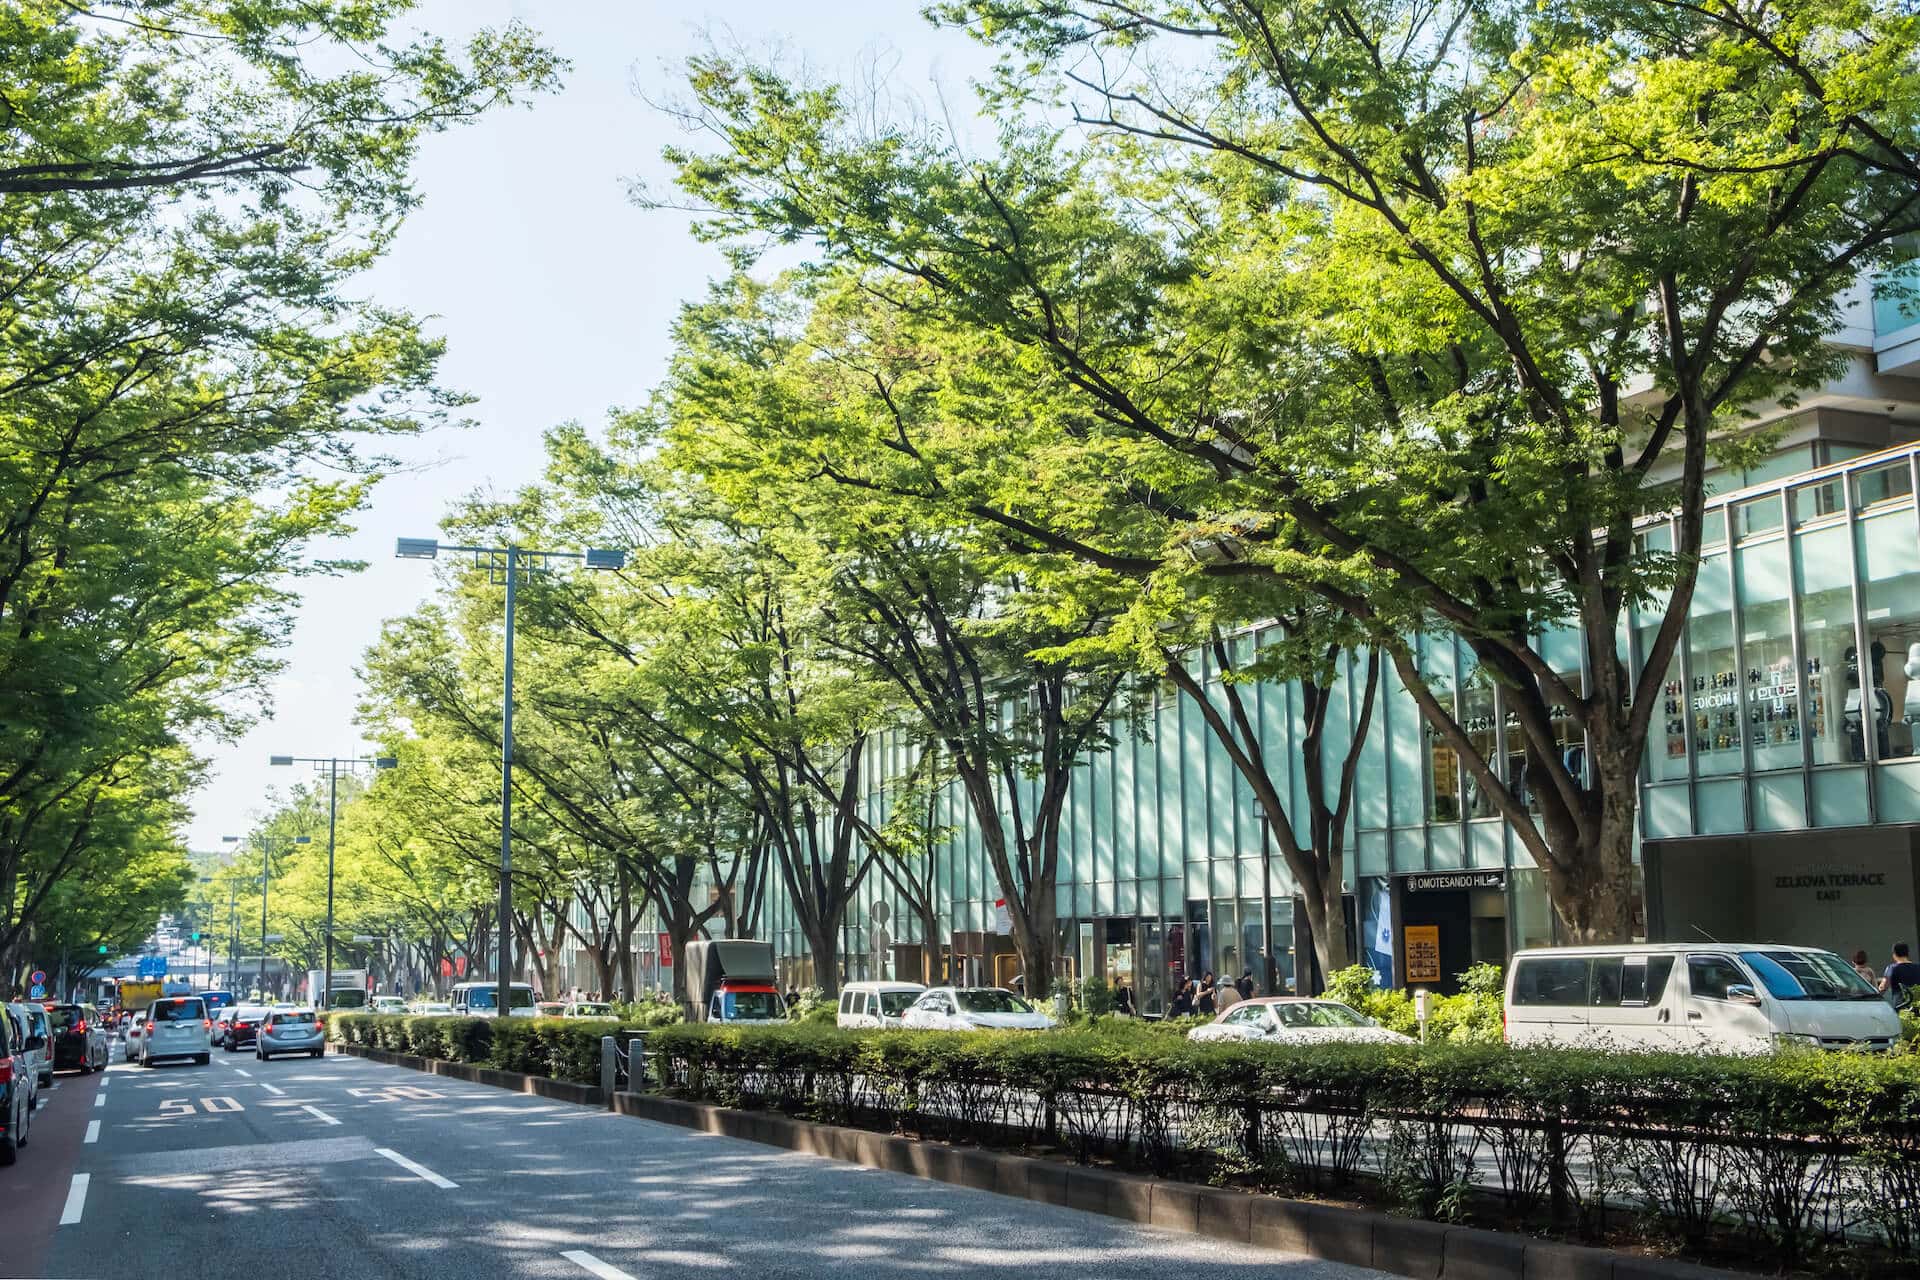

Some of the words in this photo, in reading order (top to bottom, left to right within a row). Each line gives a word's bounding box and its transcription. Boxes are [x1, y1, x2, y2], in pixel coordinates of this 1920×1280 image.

[1418, 877, 1472, 888] OMOTESANDO
[1776, 876, 1826, 889] ZELKOVA
[1828, 872, 1886, 887] TERRACE
[1816, 890, 1841, 901] EAST
[159, 1096, 245, 1117] 50
